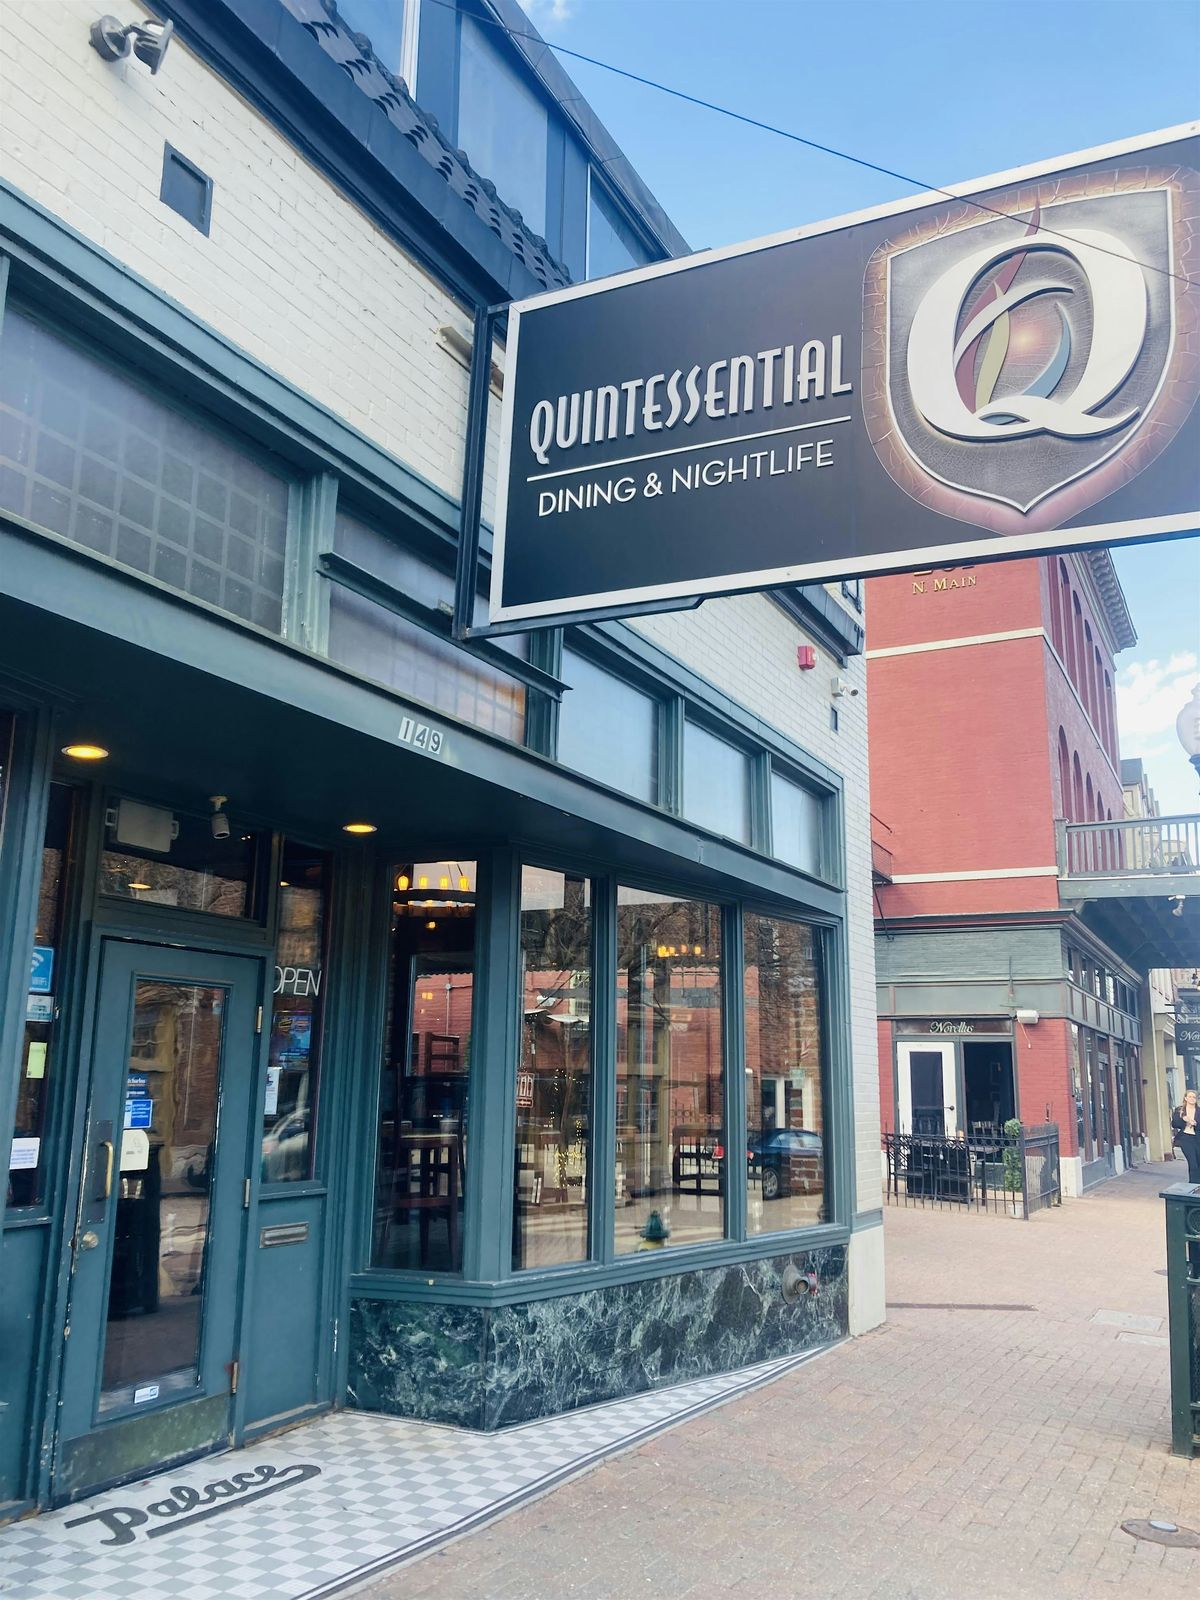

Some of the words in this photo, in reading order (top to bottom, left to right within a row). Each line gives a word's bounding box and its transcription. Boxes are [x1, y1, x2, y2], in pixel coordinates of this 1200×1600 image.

[907, 229, 1148, 441] Q
[529, 334, 852, 465] QUINTESSENTIAL
[538, 477, 636, 517] DINING
[643, 472, 663, 499] &
[671, 439, 835, 493] NIGHTLIFE
[934, 576, 976, 592] MAIN
[402, 719, 442, 752] 149
[64, 1463, 322, 1546] Palace
